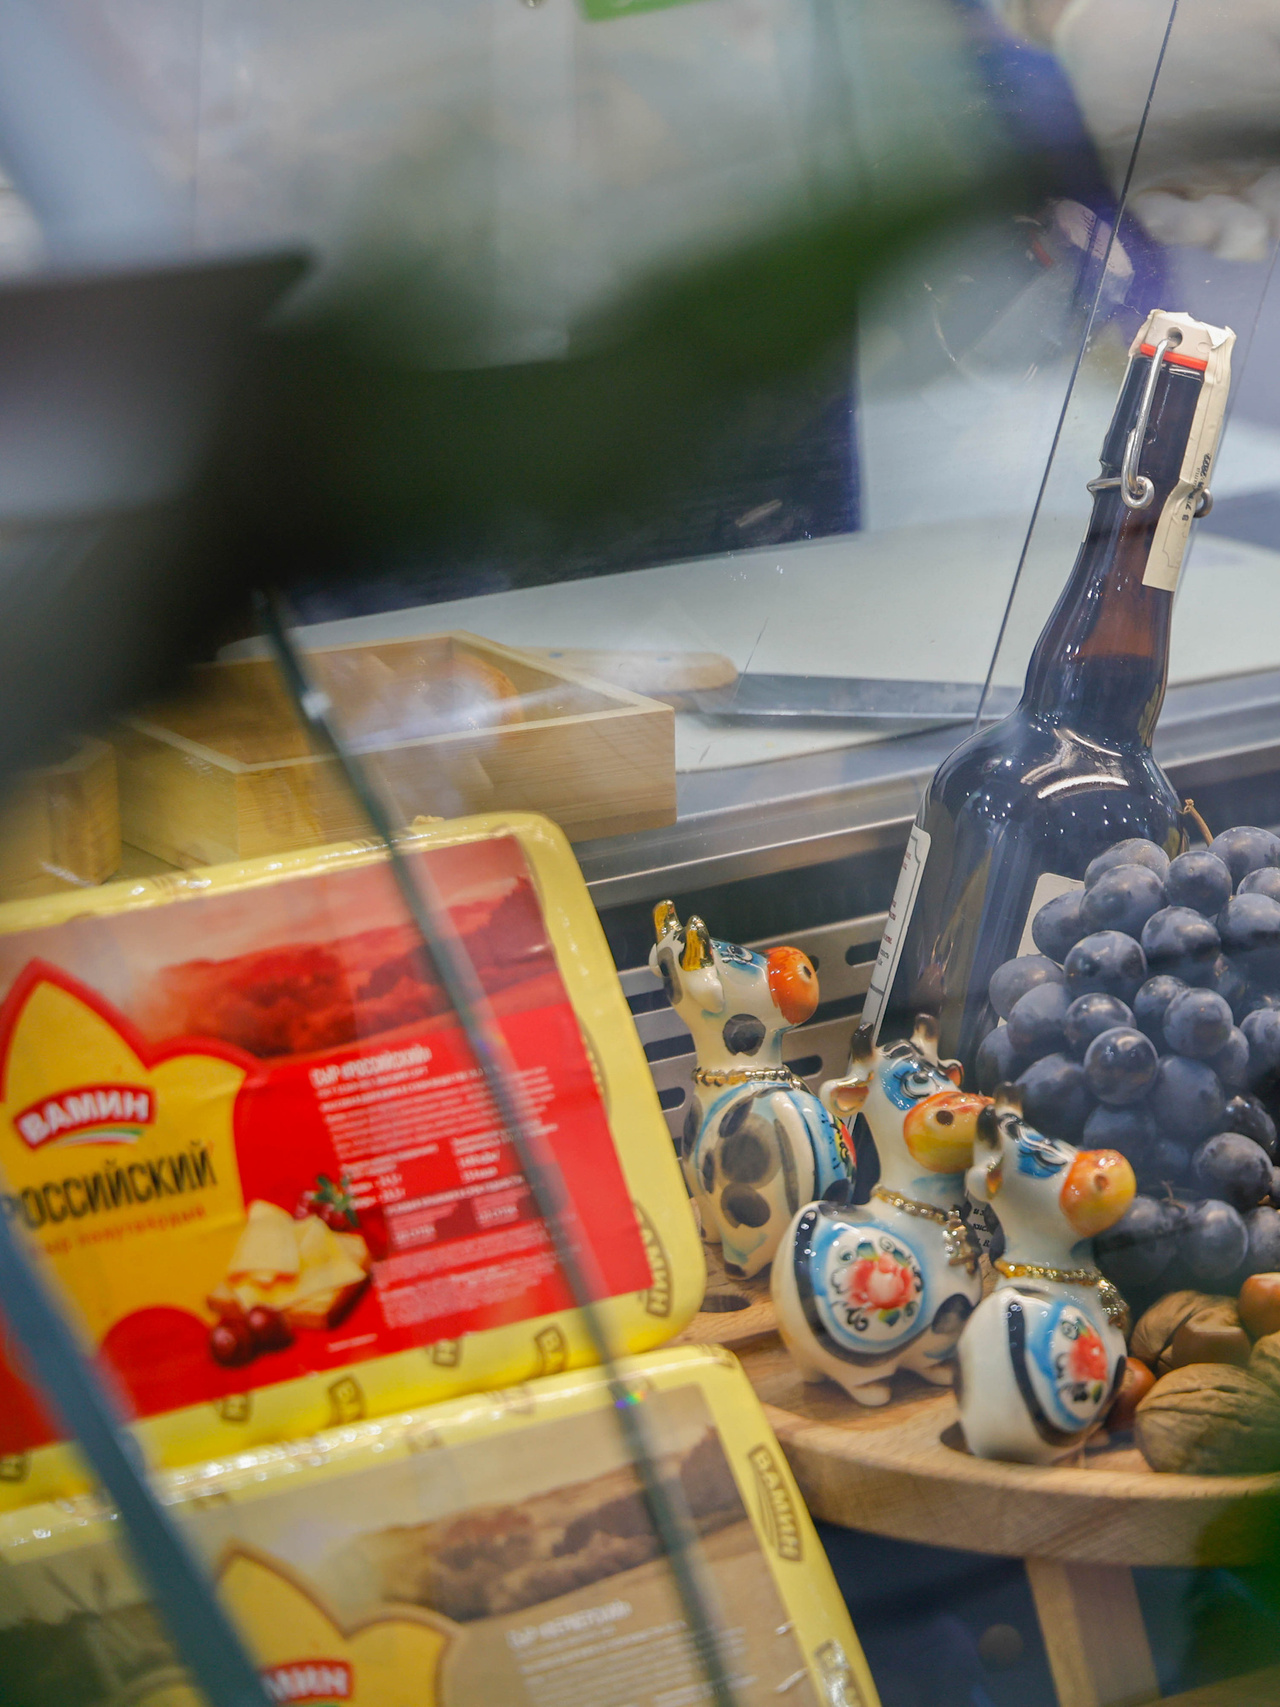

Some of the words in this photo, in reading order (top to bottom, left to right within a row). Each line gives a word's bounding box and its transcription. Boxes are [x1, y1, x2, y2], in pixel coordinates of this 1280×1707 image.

[18, 1090, 149, 1145] ВАМИН
[637, 1210, 670, 1314] АМИН
[752, 1449, 800, 1557] ВАМИН
[262, 1665, 349, 1700] МИН
